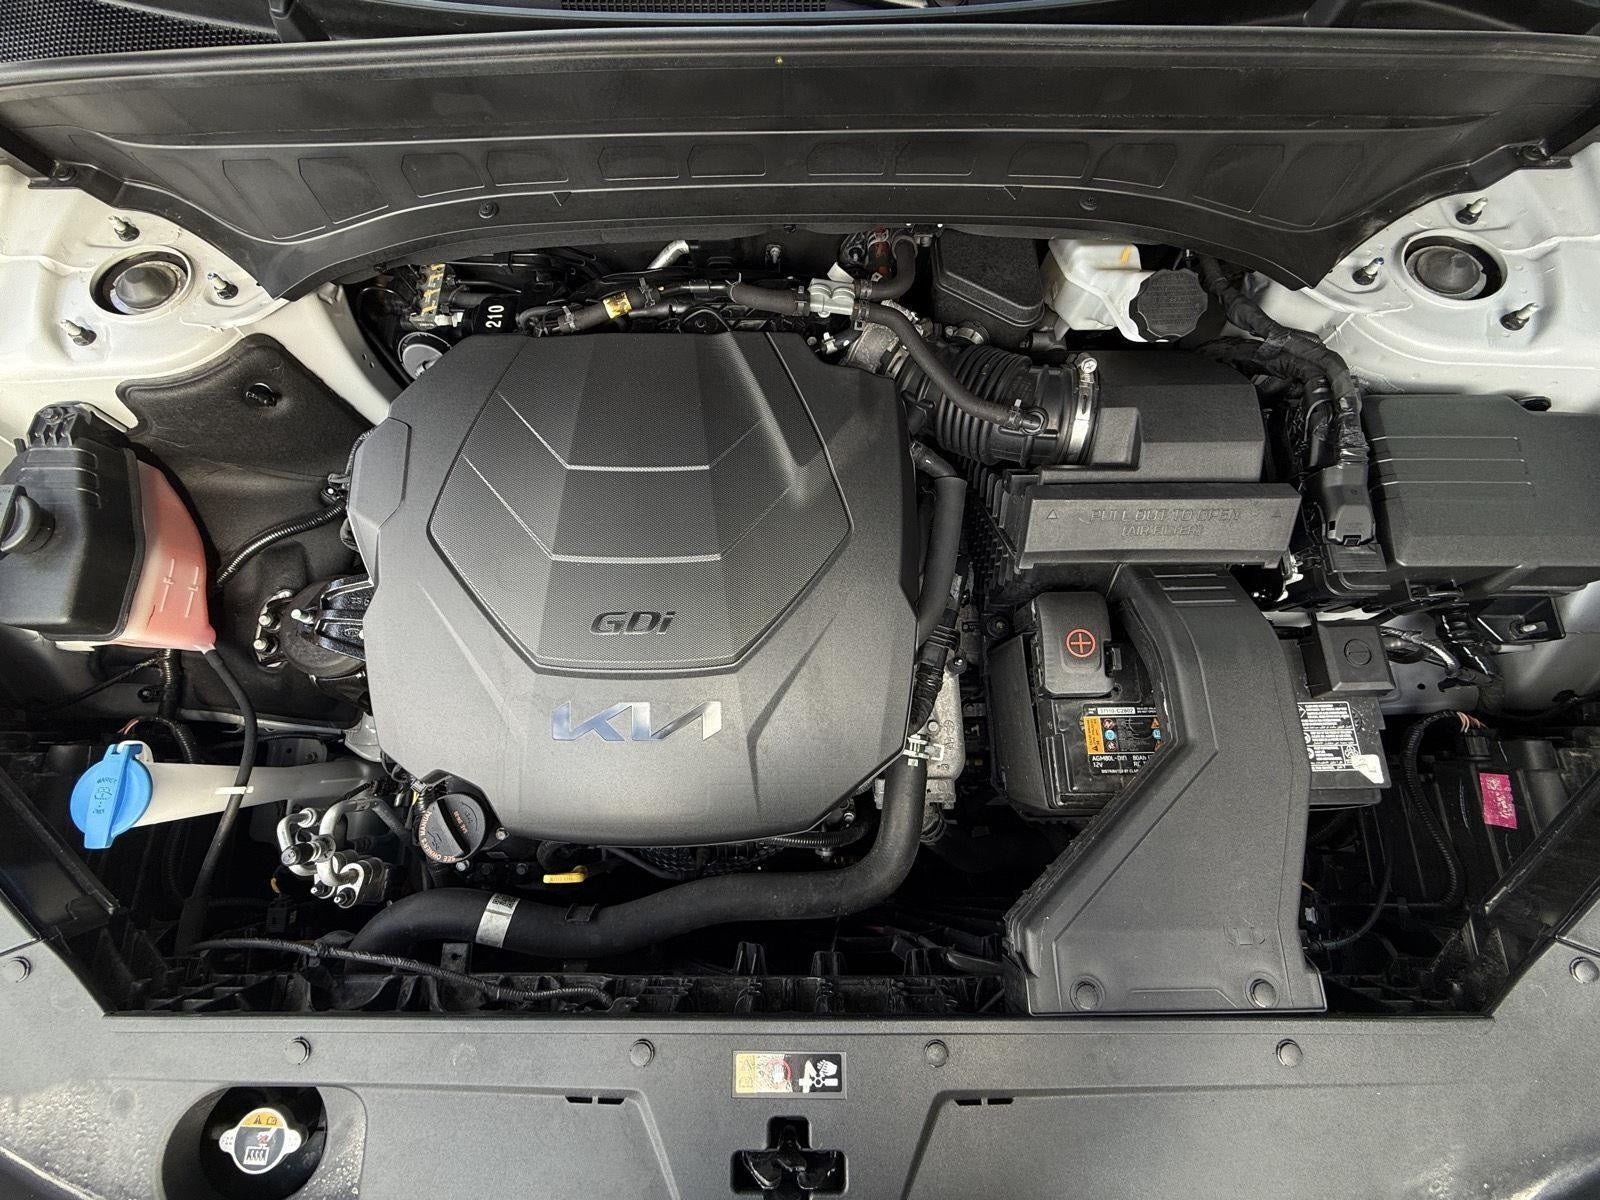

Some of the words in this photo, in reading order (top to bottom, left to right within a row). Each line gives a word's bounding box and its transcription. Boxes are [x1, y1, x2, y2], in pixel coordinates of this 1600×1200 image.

[485, 304, 505, 328] 210
[1090, 508, 1131, 522] PULL
[1134, 508, 1169, 522] OUT
[1172, 508, 1194, 522] TO
[1197, 508, 1241, 522] OPEN
[551, 700, 723, 742] KIA
[420, 811, 432, 836] MANUAL
